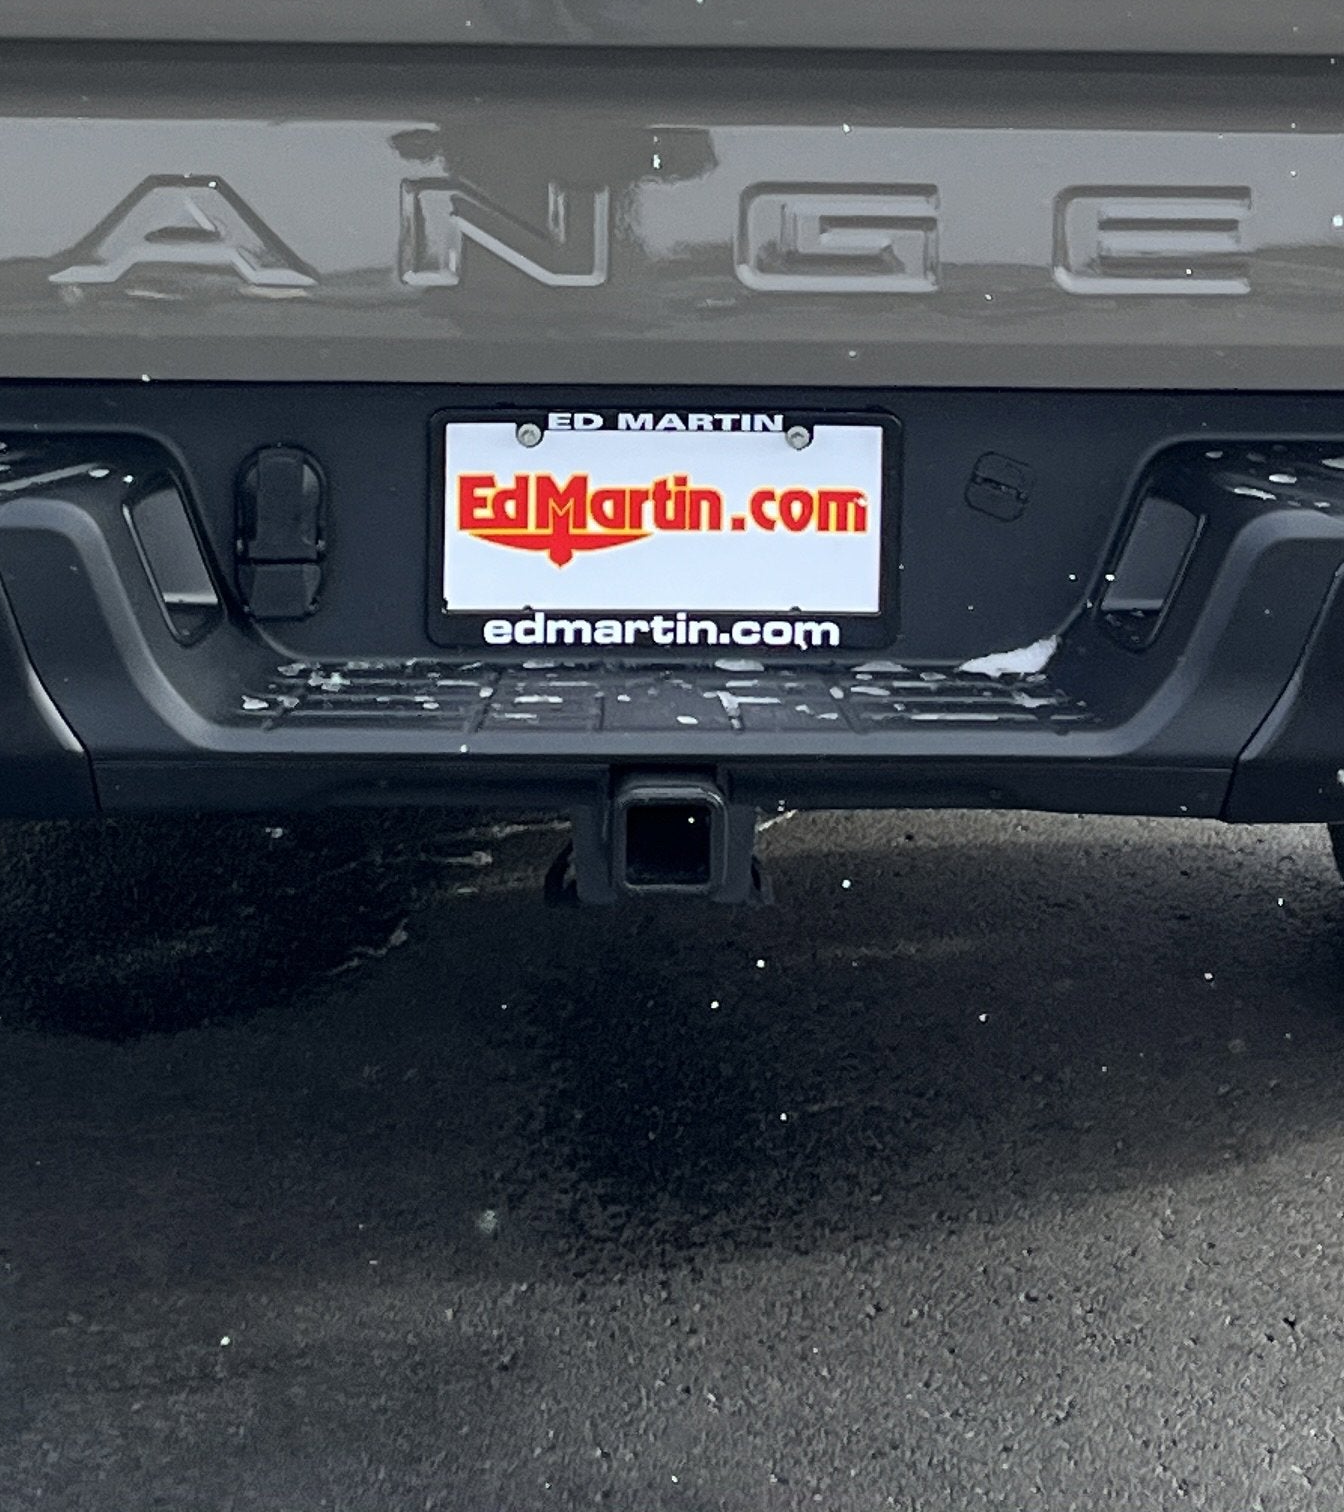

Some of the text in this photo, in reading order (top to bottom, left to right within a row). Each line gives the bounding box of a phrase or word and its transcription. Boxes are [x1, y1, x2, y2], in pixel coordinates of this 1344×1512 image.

[547, 412, 785, 433] ED MARTIN
[457, 472, 869, 535] EdMartin.com
[482, 611, 841, 648] edmartin.com
